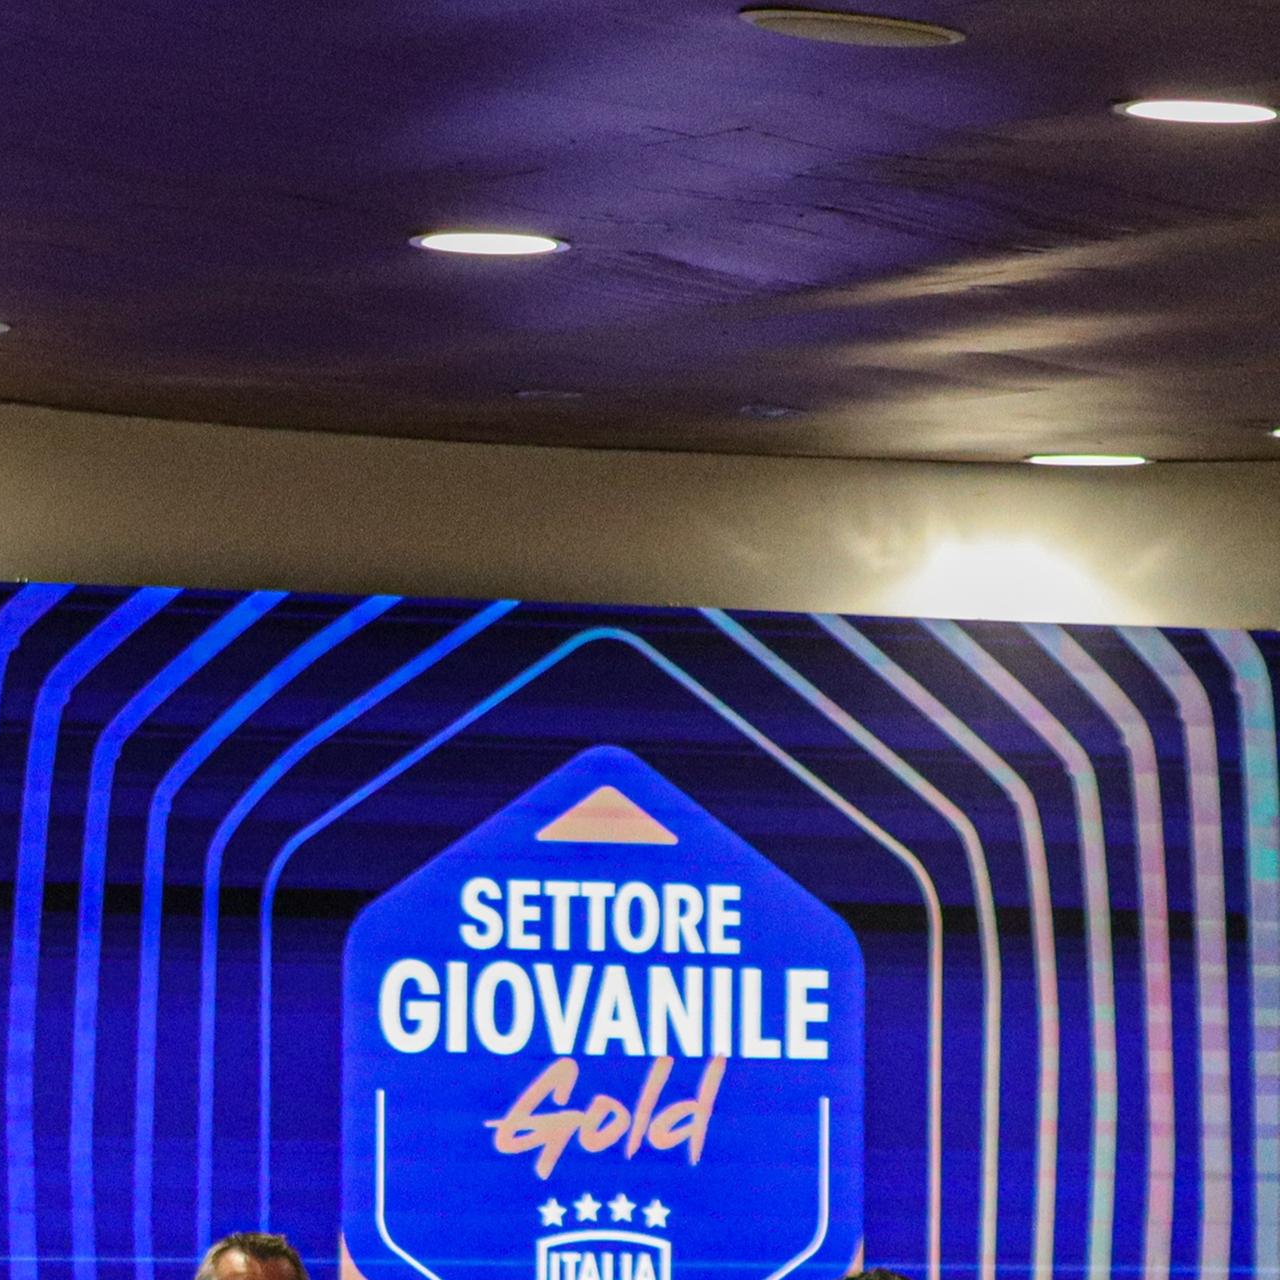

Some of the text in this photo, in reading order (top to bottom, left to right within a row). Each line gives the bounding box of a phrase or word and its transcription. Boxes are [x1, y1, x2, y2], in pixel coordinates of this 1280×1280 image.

[459, 877, 741, 955] SETTORE
[378, 958, 828, 1059] GIOVANILE
[485, 1054, 726, 1180] Gold
